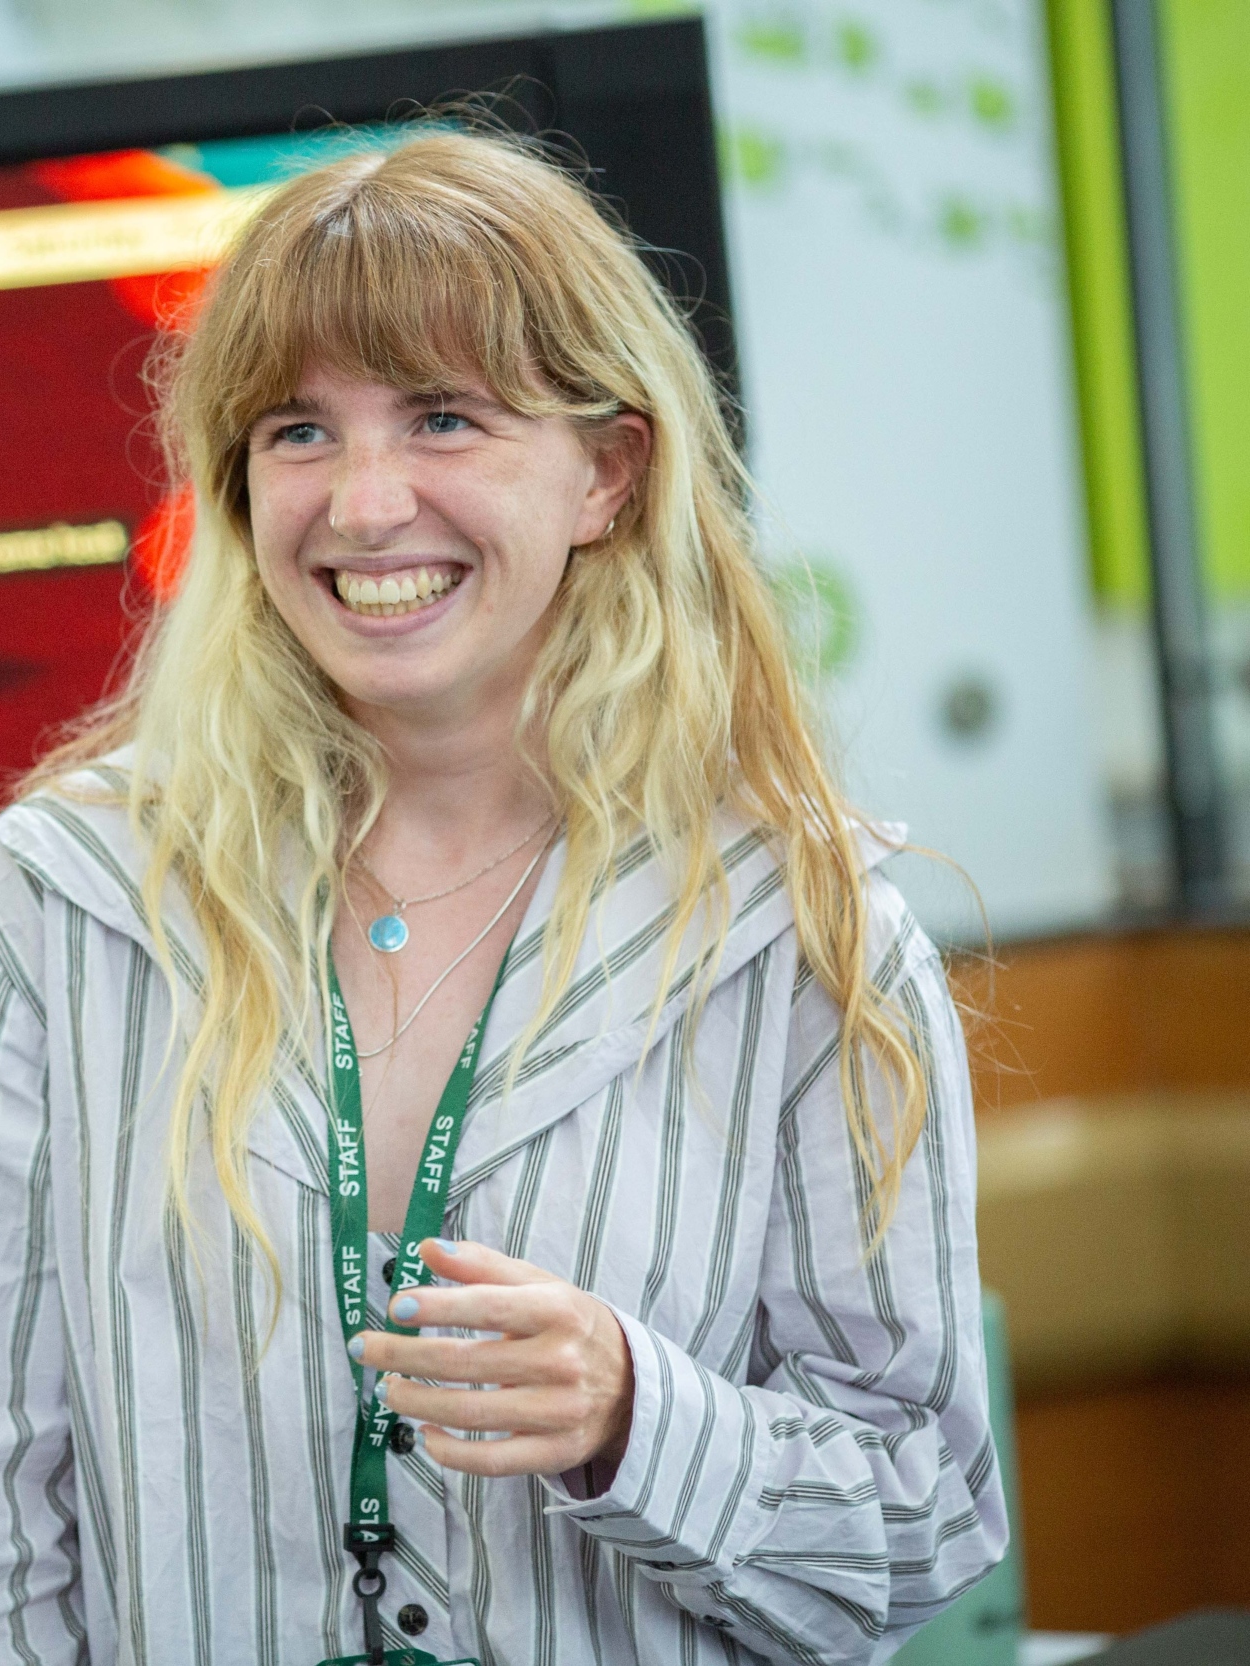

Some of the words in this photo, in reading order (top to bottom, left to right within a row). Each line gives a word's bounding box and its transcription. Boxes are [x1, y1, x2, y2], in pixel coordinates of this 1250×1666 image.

[332, 992, 354, 1070] STAFF
[337, 1118, 361, 1197] STAFF
[421, 1115, 454, 1194] STAFF
[342, 1245, 362, 1325] STAFF
[397, 1241, 424, 1291] STA
[359, 1497, 380, 1543] STA
